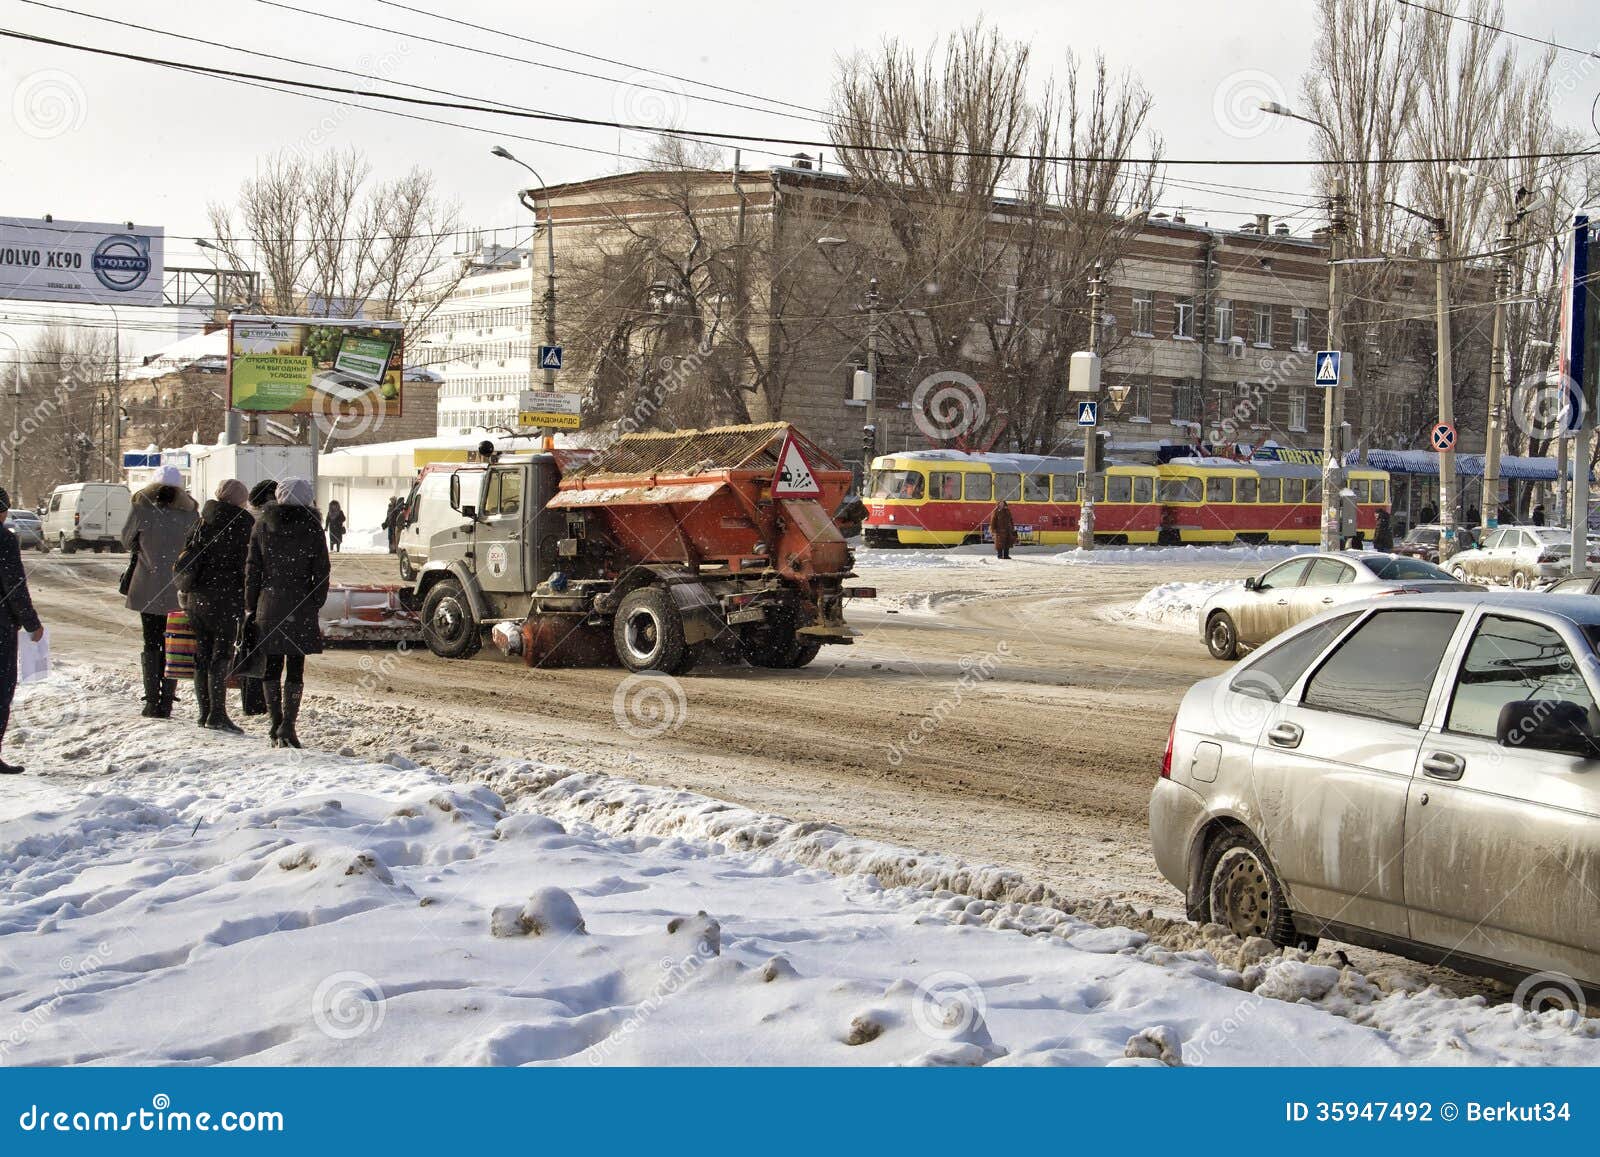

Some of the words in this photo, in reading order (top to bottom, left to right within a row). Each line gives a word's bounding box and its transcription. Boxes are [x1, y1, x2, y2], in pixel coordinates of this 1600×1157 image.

[0, 248, 40, 266] VOLVO
[47, 251, 81, 269] XC90
[95, 257, 147, 268] VOLVO
[283, 357, 307, 366] ВКЛАД
[530, 415, 577, 425] МАКДОНАЛДС
